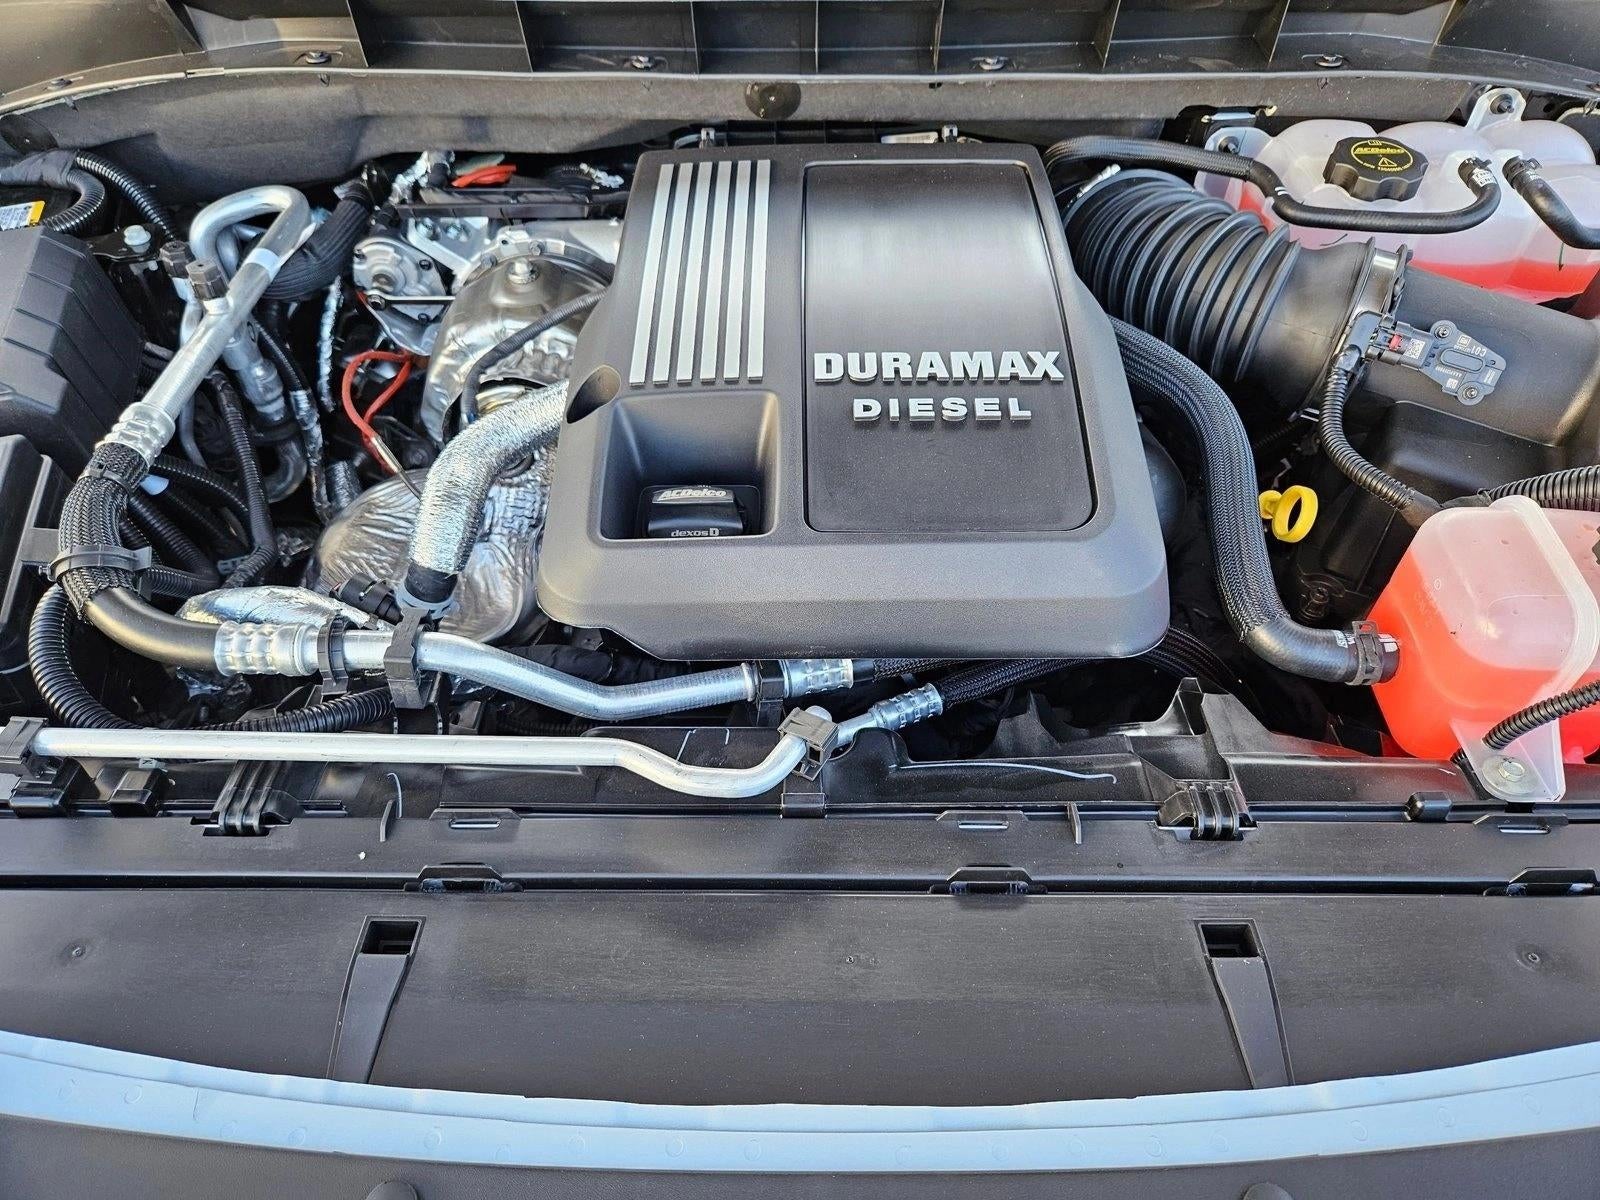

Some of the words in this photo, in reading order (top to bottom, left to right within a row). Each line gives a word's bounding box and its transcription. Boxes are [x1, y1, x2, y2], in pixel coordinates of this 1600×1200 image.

[814, 351, 1065, 383] DURAMAX
[853, 397, 1032, 422] DIESEL
[658, 489, 727, 501] ACDelco
